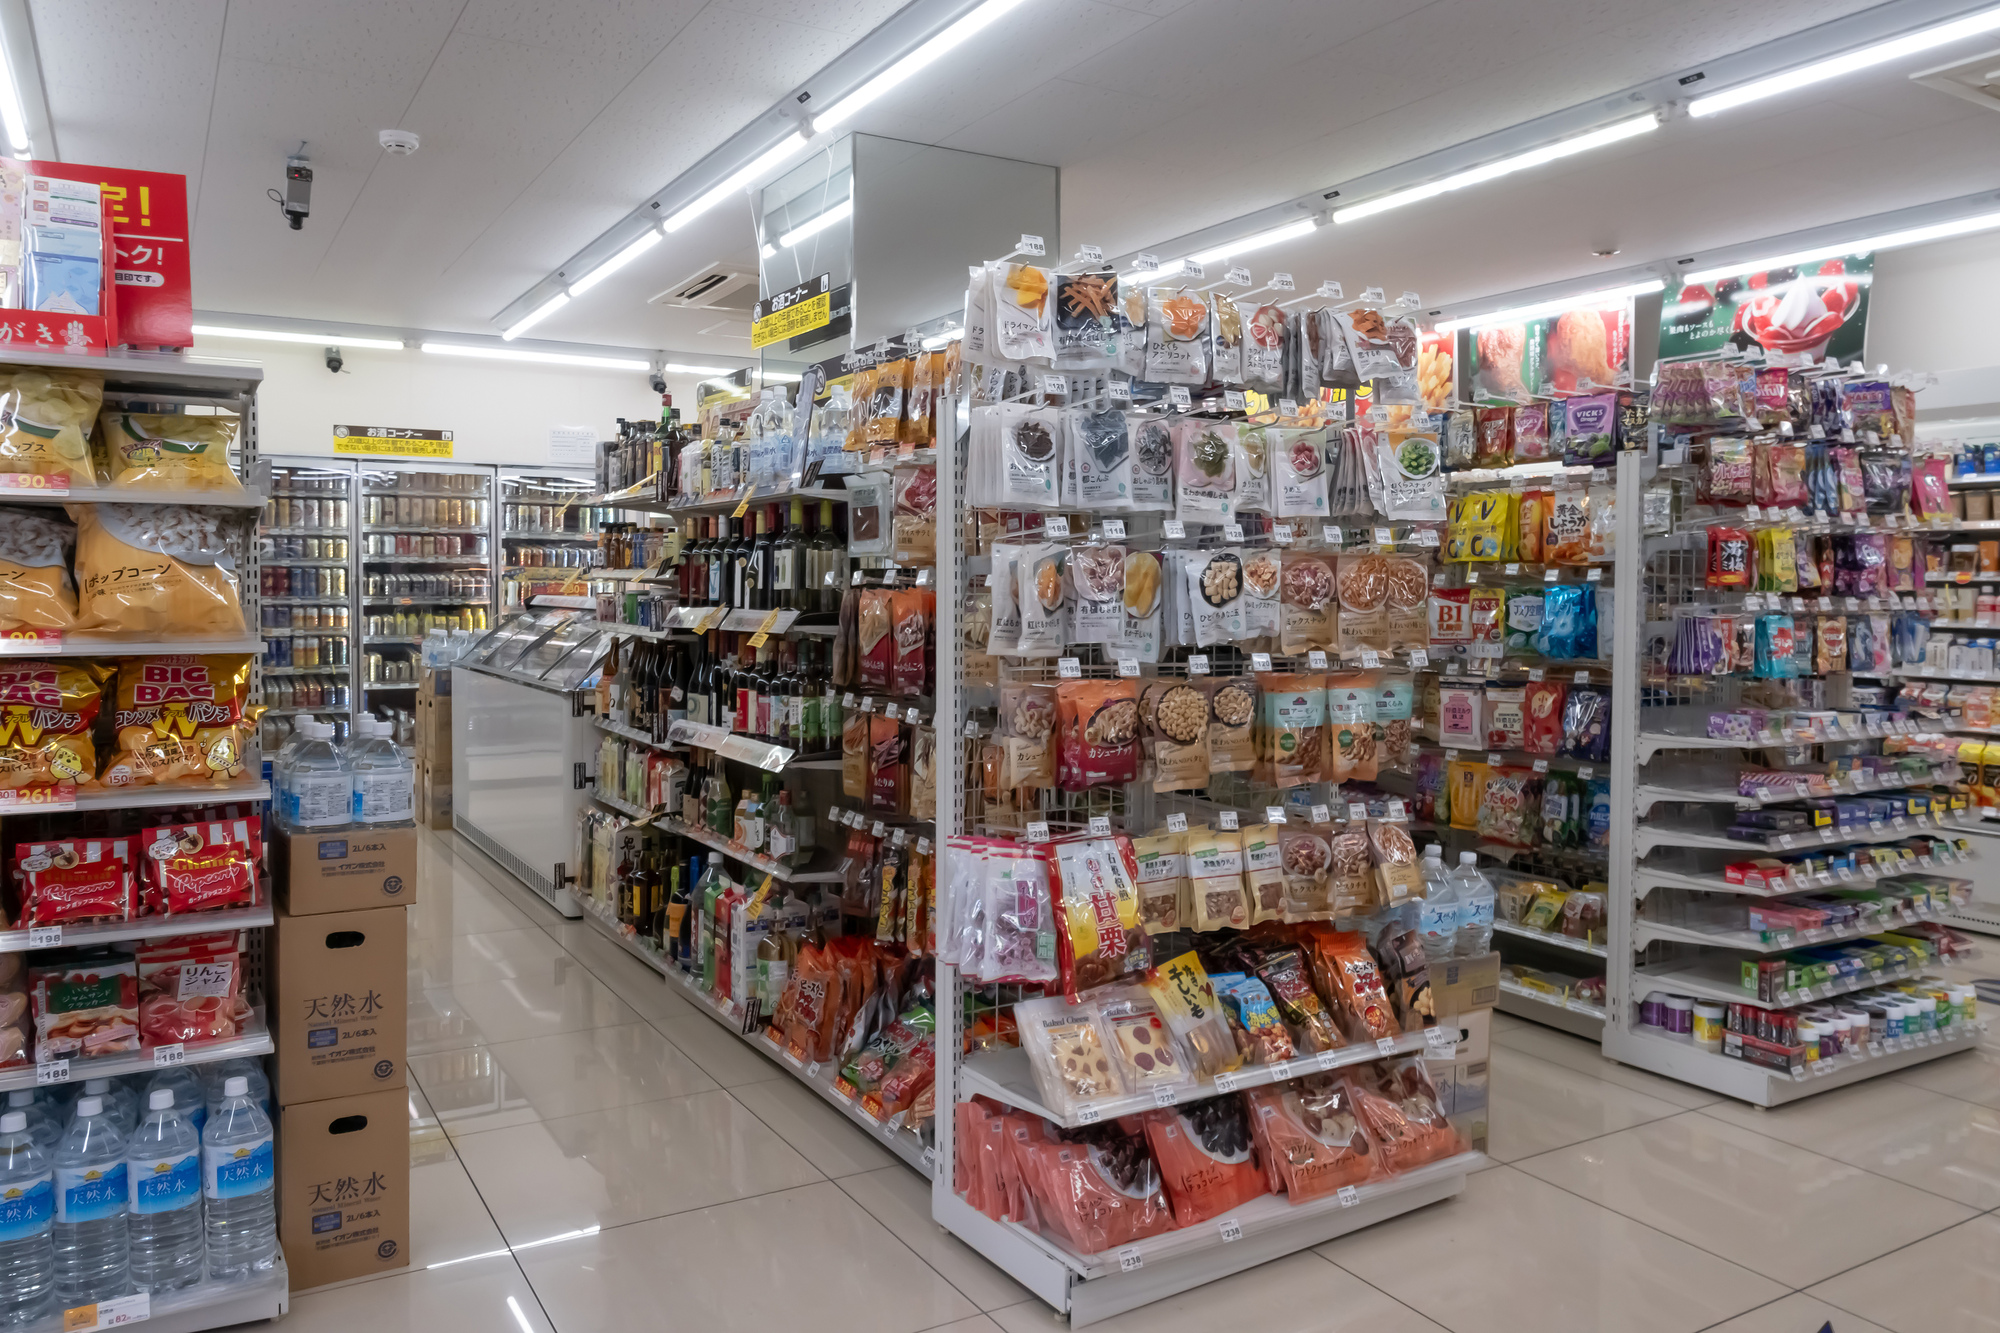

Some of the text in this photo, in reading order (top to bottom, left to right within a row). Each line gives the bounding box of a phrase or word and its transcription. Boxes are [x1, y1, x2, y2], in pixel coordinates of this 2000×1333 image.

[1028, 242, 1044, 251] 188
[771, 286, 808, 312] お酒コーナー
[1576, 409, 1603, 418] VICKS
[366, 427, 423, 438] お酒コーナー
[1082, 475, 1110, 484] 都こんぶ
[1051, 525, 1068, 533] 188
[88, 562, 172, 588] ポップコーン
[1286, 617, 1327, 627] ミックスナッツ
[1438, 604, 1462, 623] B1
[143, 664, 208, 684] BIG
[133, 683, 215, 704] BAG
[32, 709, 81, 730] パンチ
[115, 707, 160, 729] コンソメ
[187, 703, 231, 723] パンチ
[173, 866, 240, 894] Popcorn
[42, 880, 116, 903] Popcorn
[38, 935, 61, 944] 198
[186, 963, 229, 977] りんご
[185, 974, 226, 986] ジャム
[303, 989, 385, 1022] 天然水
[1042, 1014, 1090, 1028] Baked Cheese
[161, 1051, 184, 1063] 188
[45, 1068, 69, 1080] 188
[1083, 1110, 1099, 1120] 238
[222, 1161, 264, 1182] 天然水
[73, 1185, 117, 1205] 天然水
[143, 1177, 187, 1197] 天然水
[308, 1171, 388, 1207] 天然水
[1125, 1256, 1142, 1266] 238
